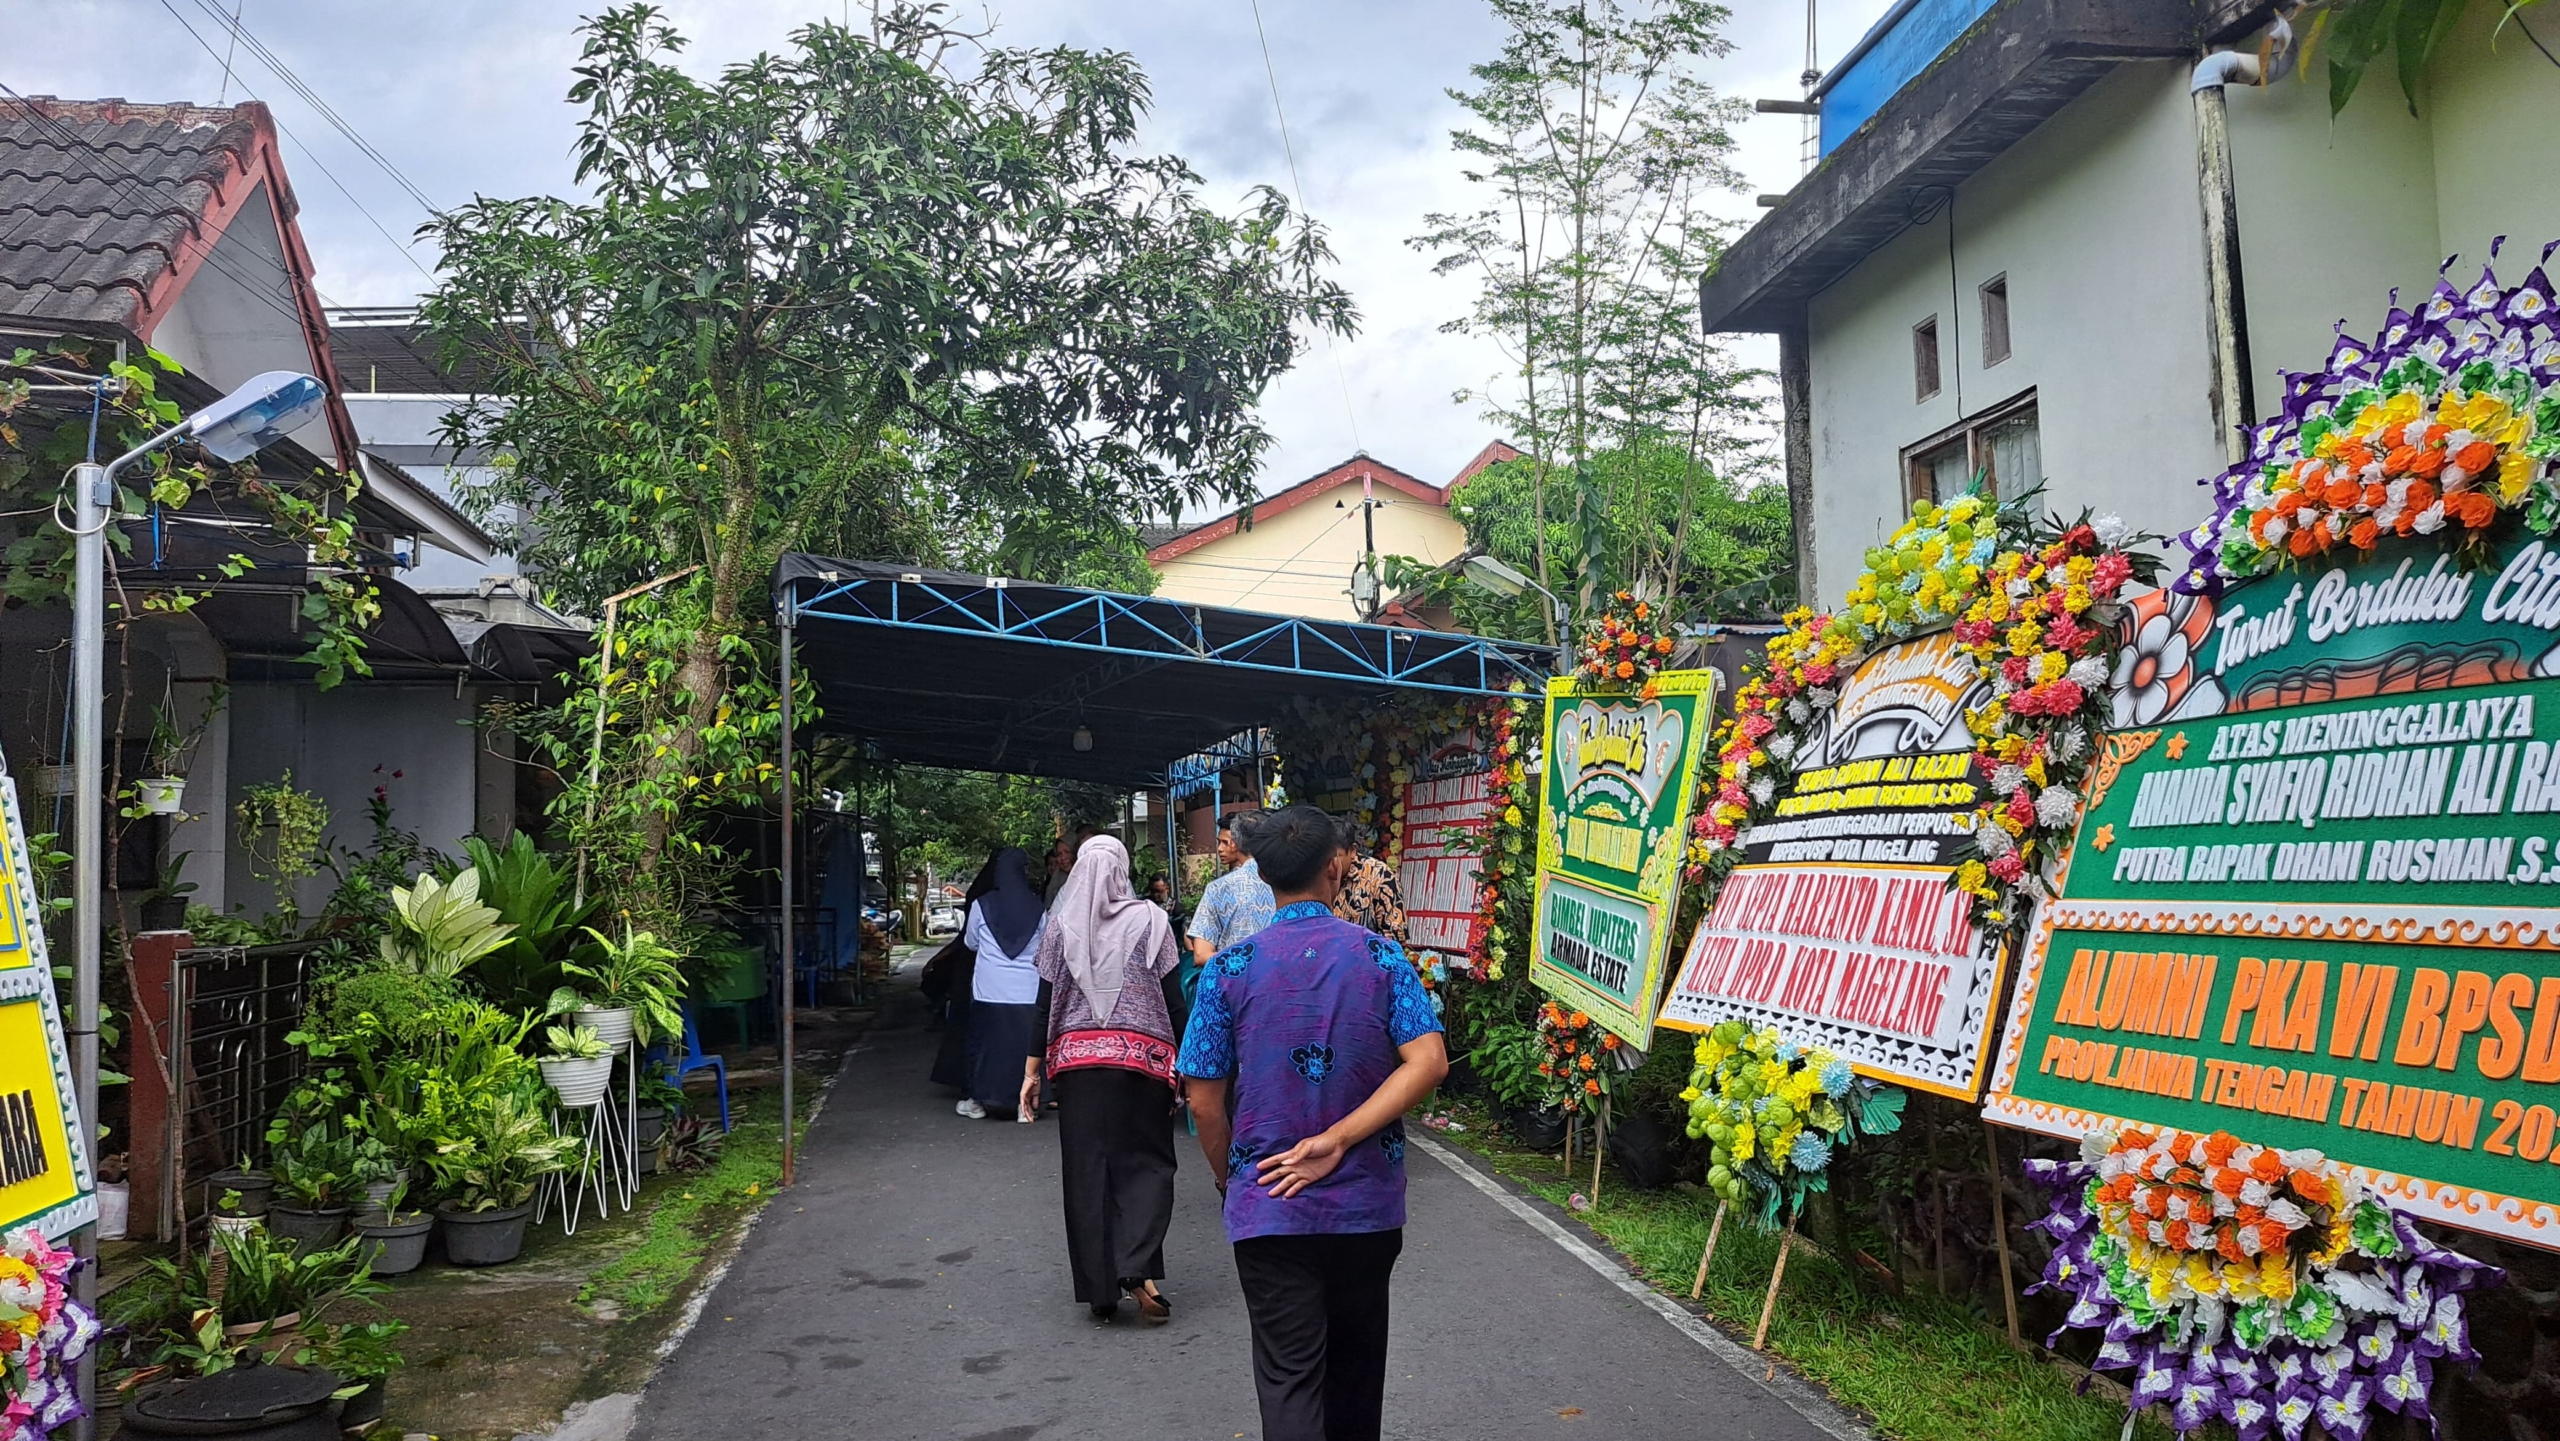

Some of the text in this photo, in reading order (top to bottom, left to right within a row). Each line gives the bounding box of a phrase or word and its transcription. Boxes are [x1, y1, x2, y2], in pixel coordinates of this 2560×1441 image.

[2213, 582, 2304, 677] Turut
[2307, 553, 2475, 642] Berduka
[2208, 695, 2535, 761] ATAS MENINGGALNYA
[1881, 757, 1913, 781] ALI
[1910, 752, 1973, 780] RAZAN
[2129, 762, 2231, 828] ANANDA
[2227, 757, 2329, 828] SYAFIQ
[2320, 747, 2453, 819] RIDHAN
[2447, 741, 2517, 815] ALI
[1831, 839, 1863, 861] KOTA
[1862, 839, 1940, 863] MAGELANG
[2113, 846, 2188, 882] PUTRA
[2187, 843, 2275, 882] BAPAK
[2271, 841, 2365, 882] DHANI
[1550, 892, 1639, 962] BIMBEL JUPITERS
[1778, 873, 1879, 943] HARYANTO
[1550, 931, 1630, 995] ARMADA ESTATE
[1686, 936, 1951, 1037] KETUA DPRD KOTA MAGELANG
[2054, 949, 2219, 1040] ALUMNI
[2220, 957, 2328, 1053] PKA
[2329, 962, 2399, 1061] VI
[2201, 1058, 2336, 1123] TENGAH
[2339, 1078, 2484, 1150] TAHUN
